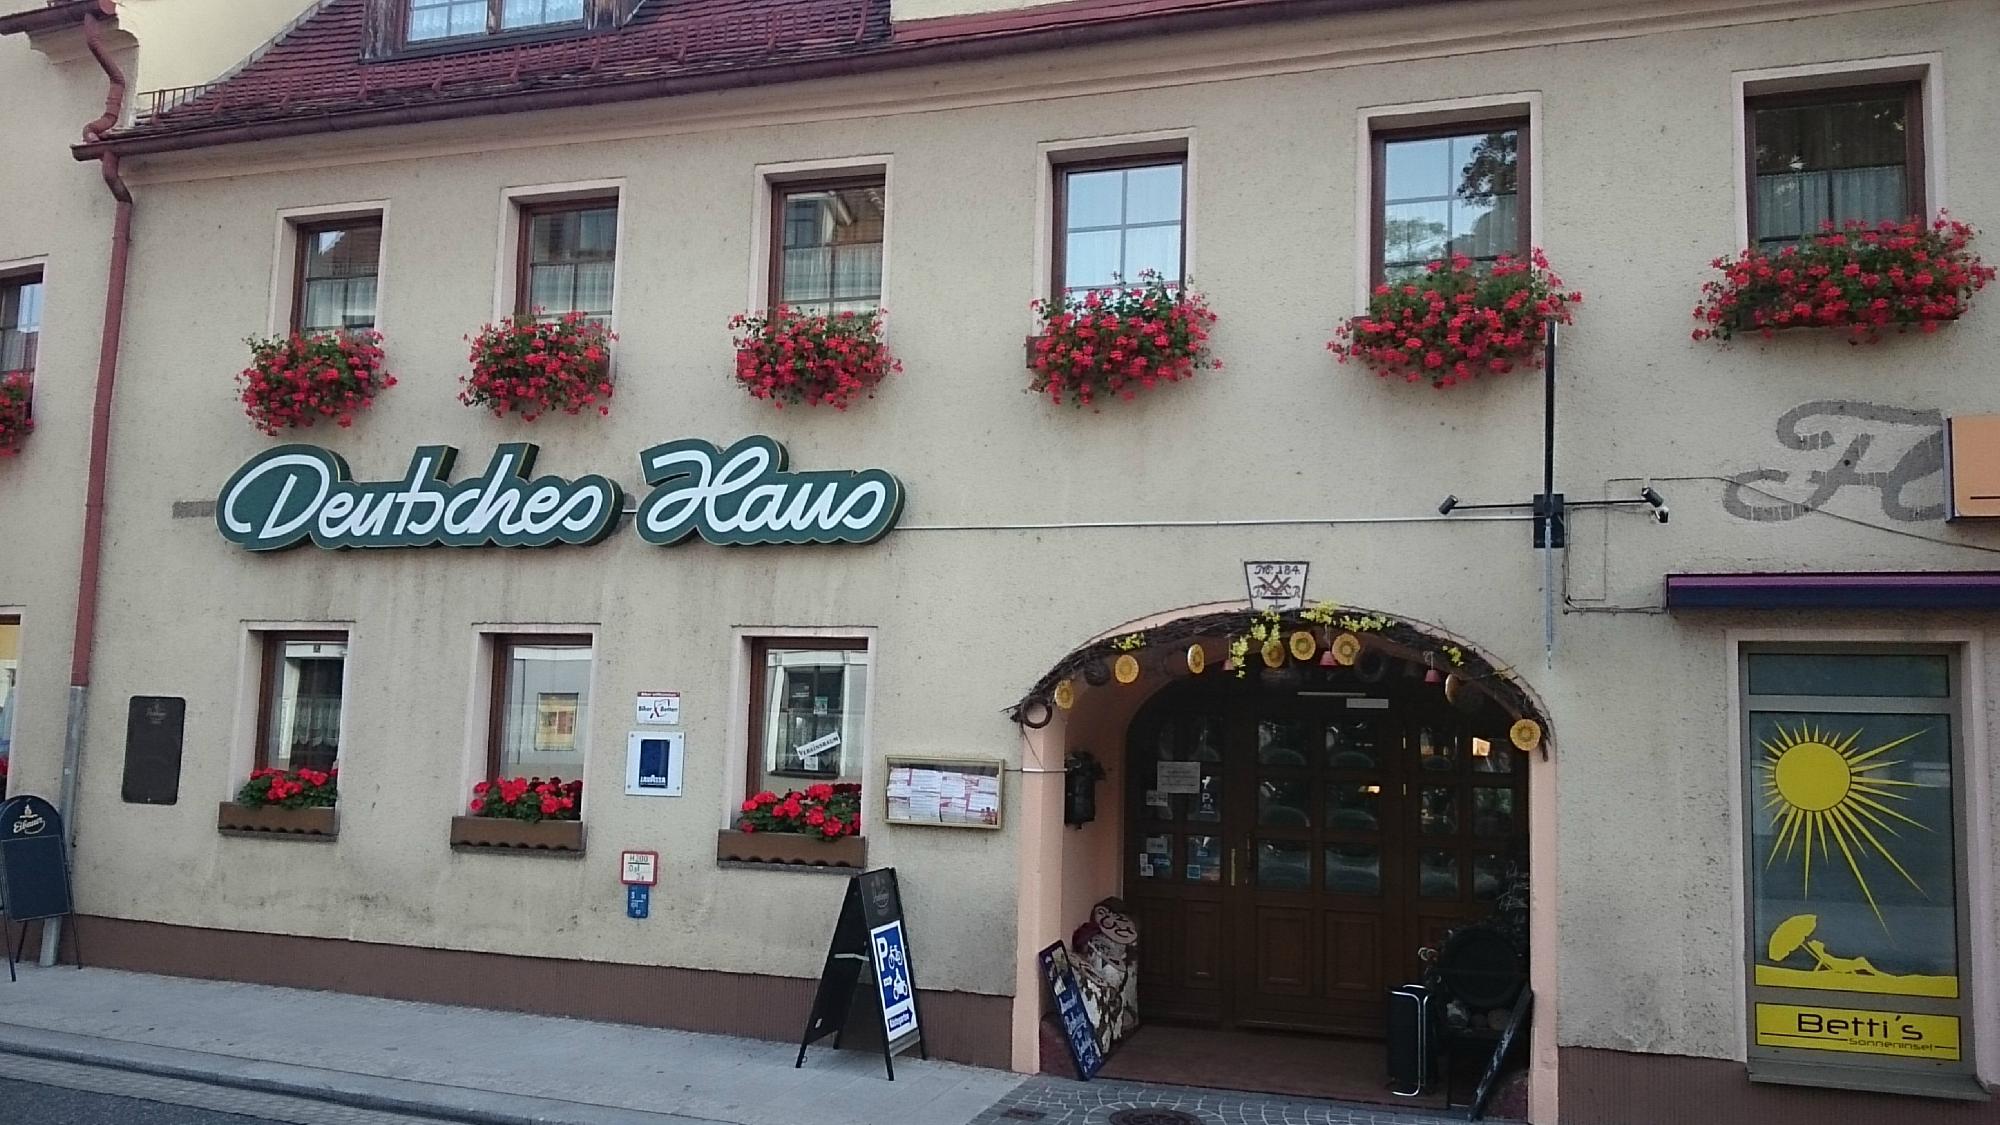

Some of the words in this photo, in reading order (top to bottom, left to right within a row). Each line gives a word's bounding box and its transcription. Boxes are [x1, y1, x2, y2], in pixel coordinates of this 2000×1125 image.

[226, 452, 599, 539] Deutsches
[646, 446, 886, 531] Haus
[876, 937, 888, 971] P
[1848, 1037, 1934, 1052] Sonneninsel
